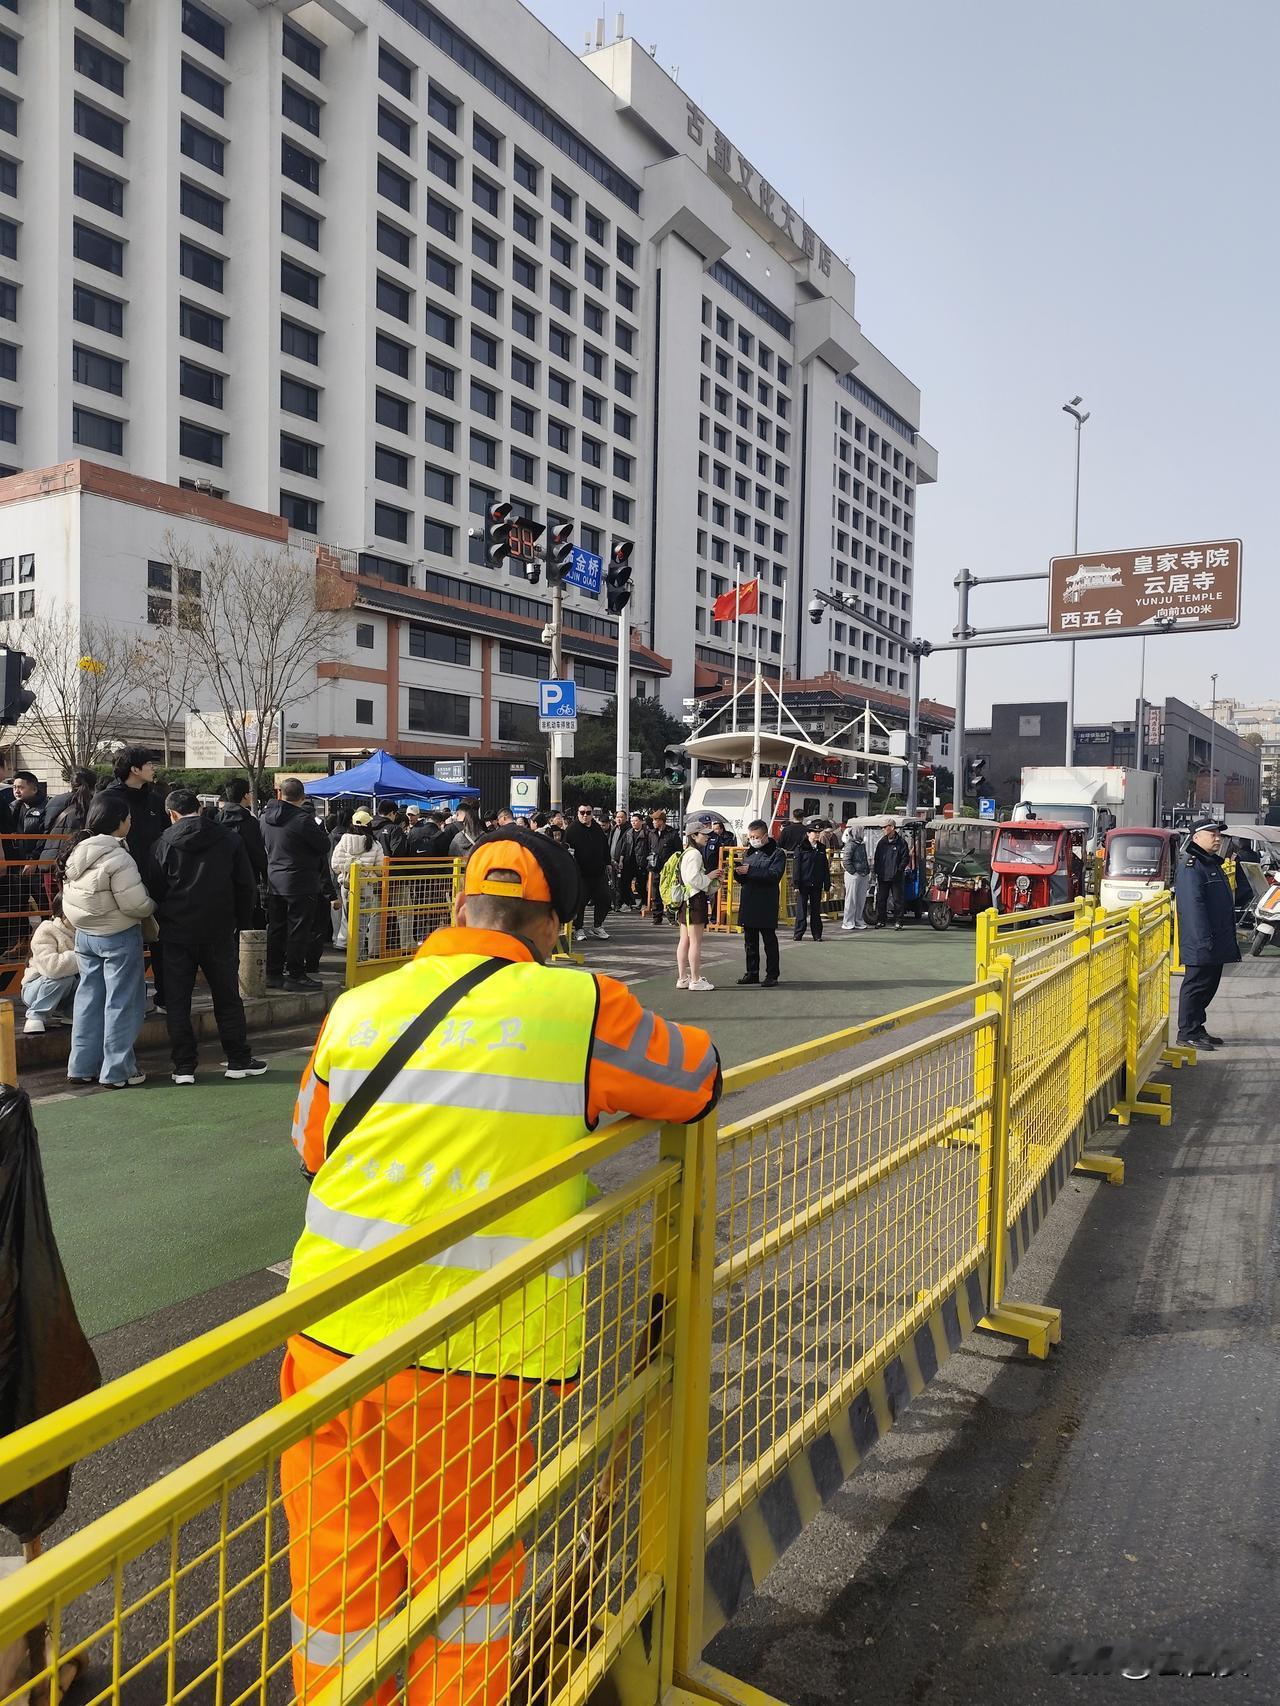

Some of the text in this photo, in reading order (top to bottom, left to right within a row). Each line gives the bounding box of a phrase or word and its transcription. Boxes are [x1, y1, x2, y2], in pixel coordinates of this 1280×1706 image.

[1132, 548, 1230, 575] 皇家寺院
[582, 576, 597, 588] QIAO
[1143, 571, 1216, 595] 云居寺
[1135, 592, 1223, 606] YUNJU TEMPLE
[1060, 607, 1124, 629] 西五台
[1157, 604, 1212, 617] 向前100米
[541, 684, 563, 714] P
[980, 800, 990, 812] P
